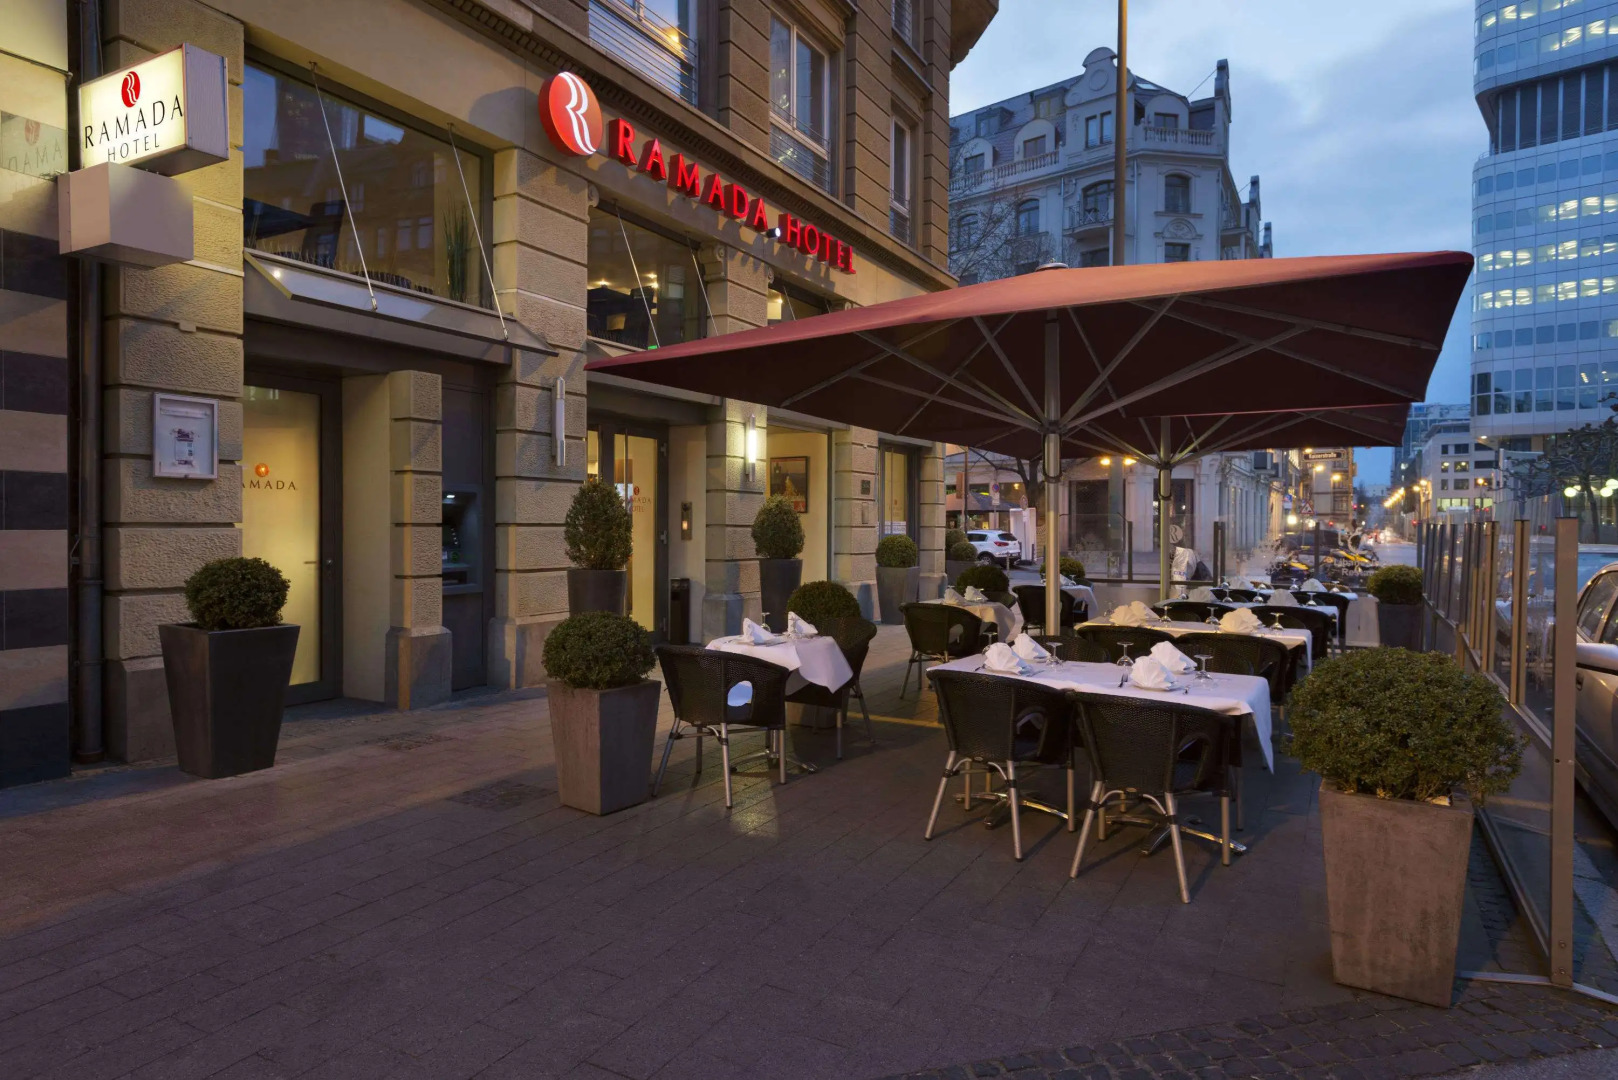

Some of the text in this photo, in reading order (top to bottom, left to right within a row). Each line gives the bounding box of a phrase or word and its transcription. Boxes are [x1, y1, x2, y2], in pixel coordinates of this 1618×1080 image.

[84, 94, 184, 149] RAMADA
[107, 133, 160, 162] HOTEL
[608, 117, 857, 275] RAMADA HOTEL
